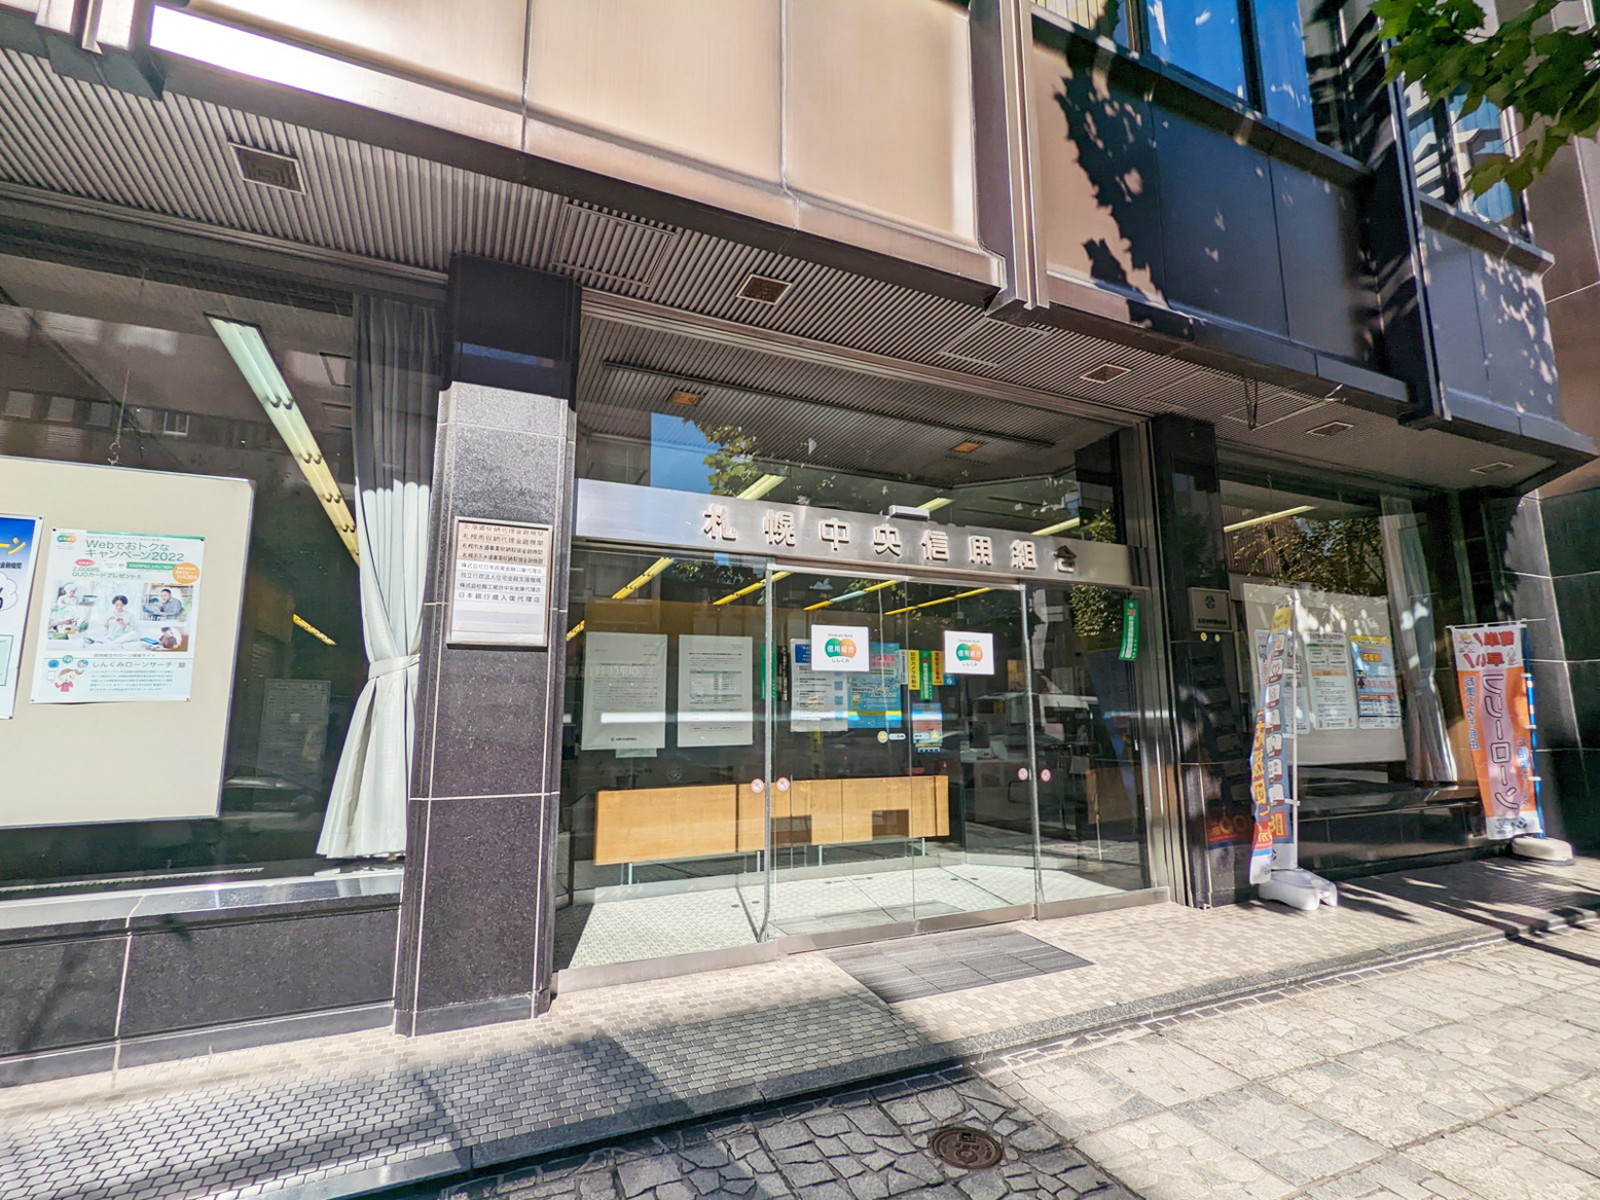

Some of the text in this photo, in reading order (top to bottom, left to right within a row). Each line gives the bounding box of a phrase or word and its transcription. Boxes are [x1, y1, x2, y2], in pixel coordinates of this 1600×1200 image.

[702, 503, 1078, 573] 札幌中央信用組合
[86, 539, 170, 552] Webでおトクな
[85, 549, 185, 562] キャンペーン2022
[827, 645, 854, 654] 信用組合
[957, 650, 982, 658] 信用組合
[93, 660, 173, 668] しんくみローンサーチ
